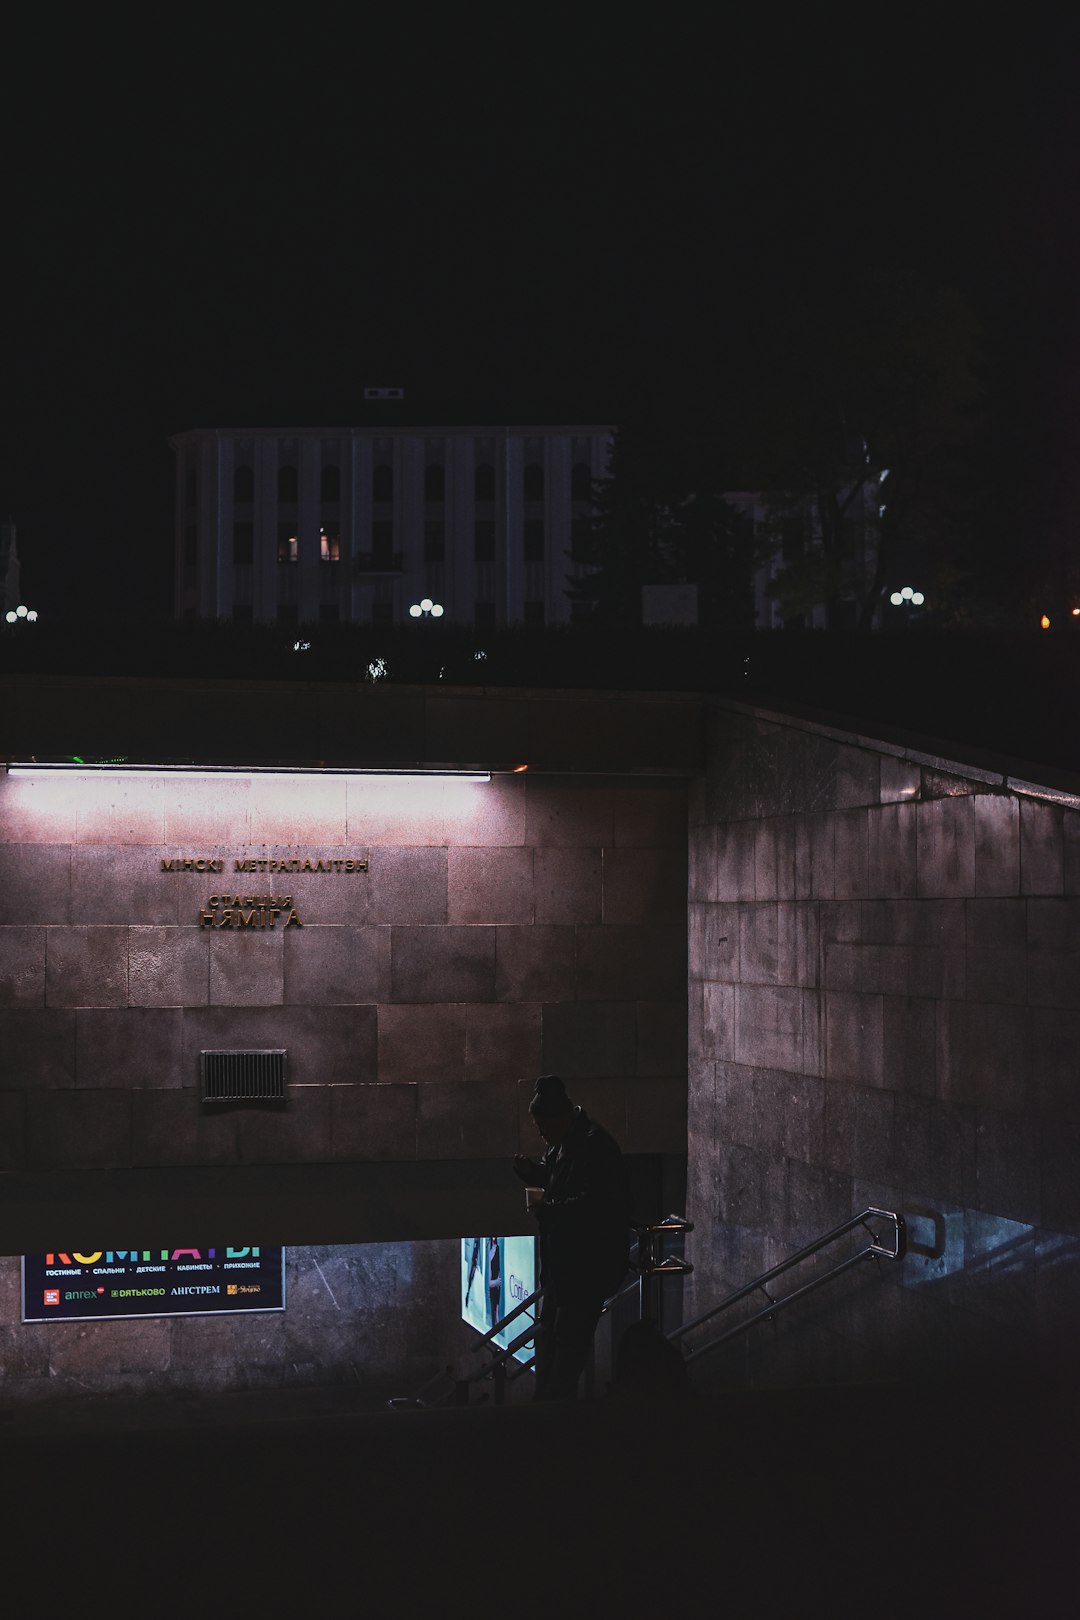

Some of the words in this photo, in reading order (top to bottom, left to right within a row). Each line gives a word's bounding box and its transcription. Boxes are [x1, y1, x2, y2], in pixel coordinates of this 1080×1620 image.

[161, 859, 223, 872] МІНСКІ
[234, 859, 369, 872] МЕТРАПАЛІТЭН
[208, 895, 292, 908] СТАНЦЫЯ
[200, 908, 303, 928] НЯМІГА
[45, 1269, 82, 1277] ГОСТИНЫЕ
[92, 1267, 125, 1275] СПАЛЬНИ
[136, 1266, 166, 1274] ДЕТСКИЕ
[176, 1263, 212, 1271] КАБИНЕТЫ
[64, 1290, 98, 1300] anrex
[170, 1285, 220, 1296] АНГСТРЕМ
